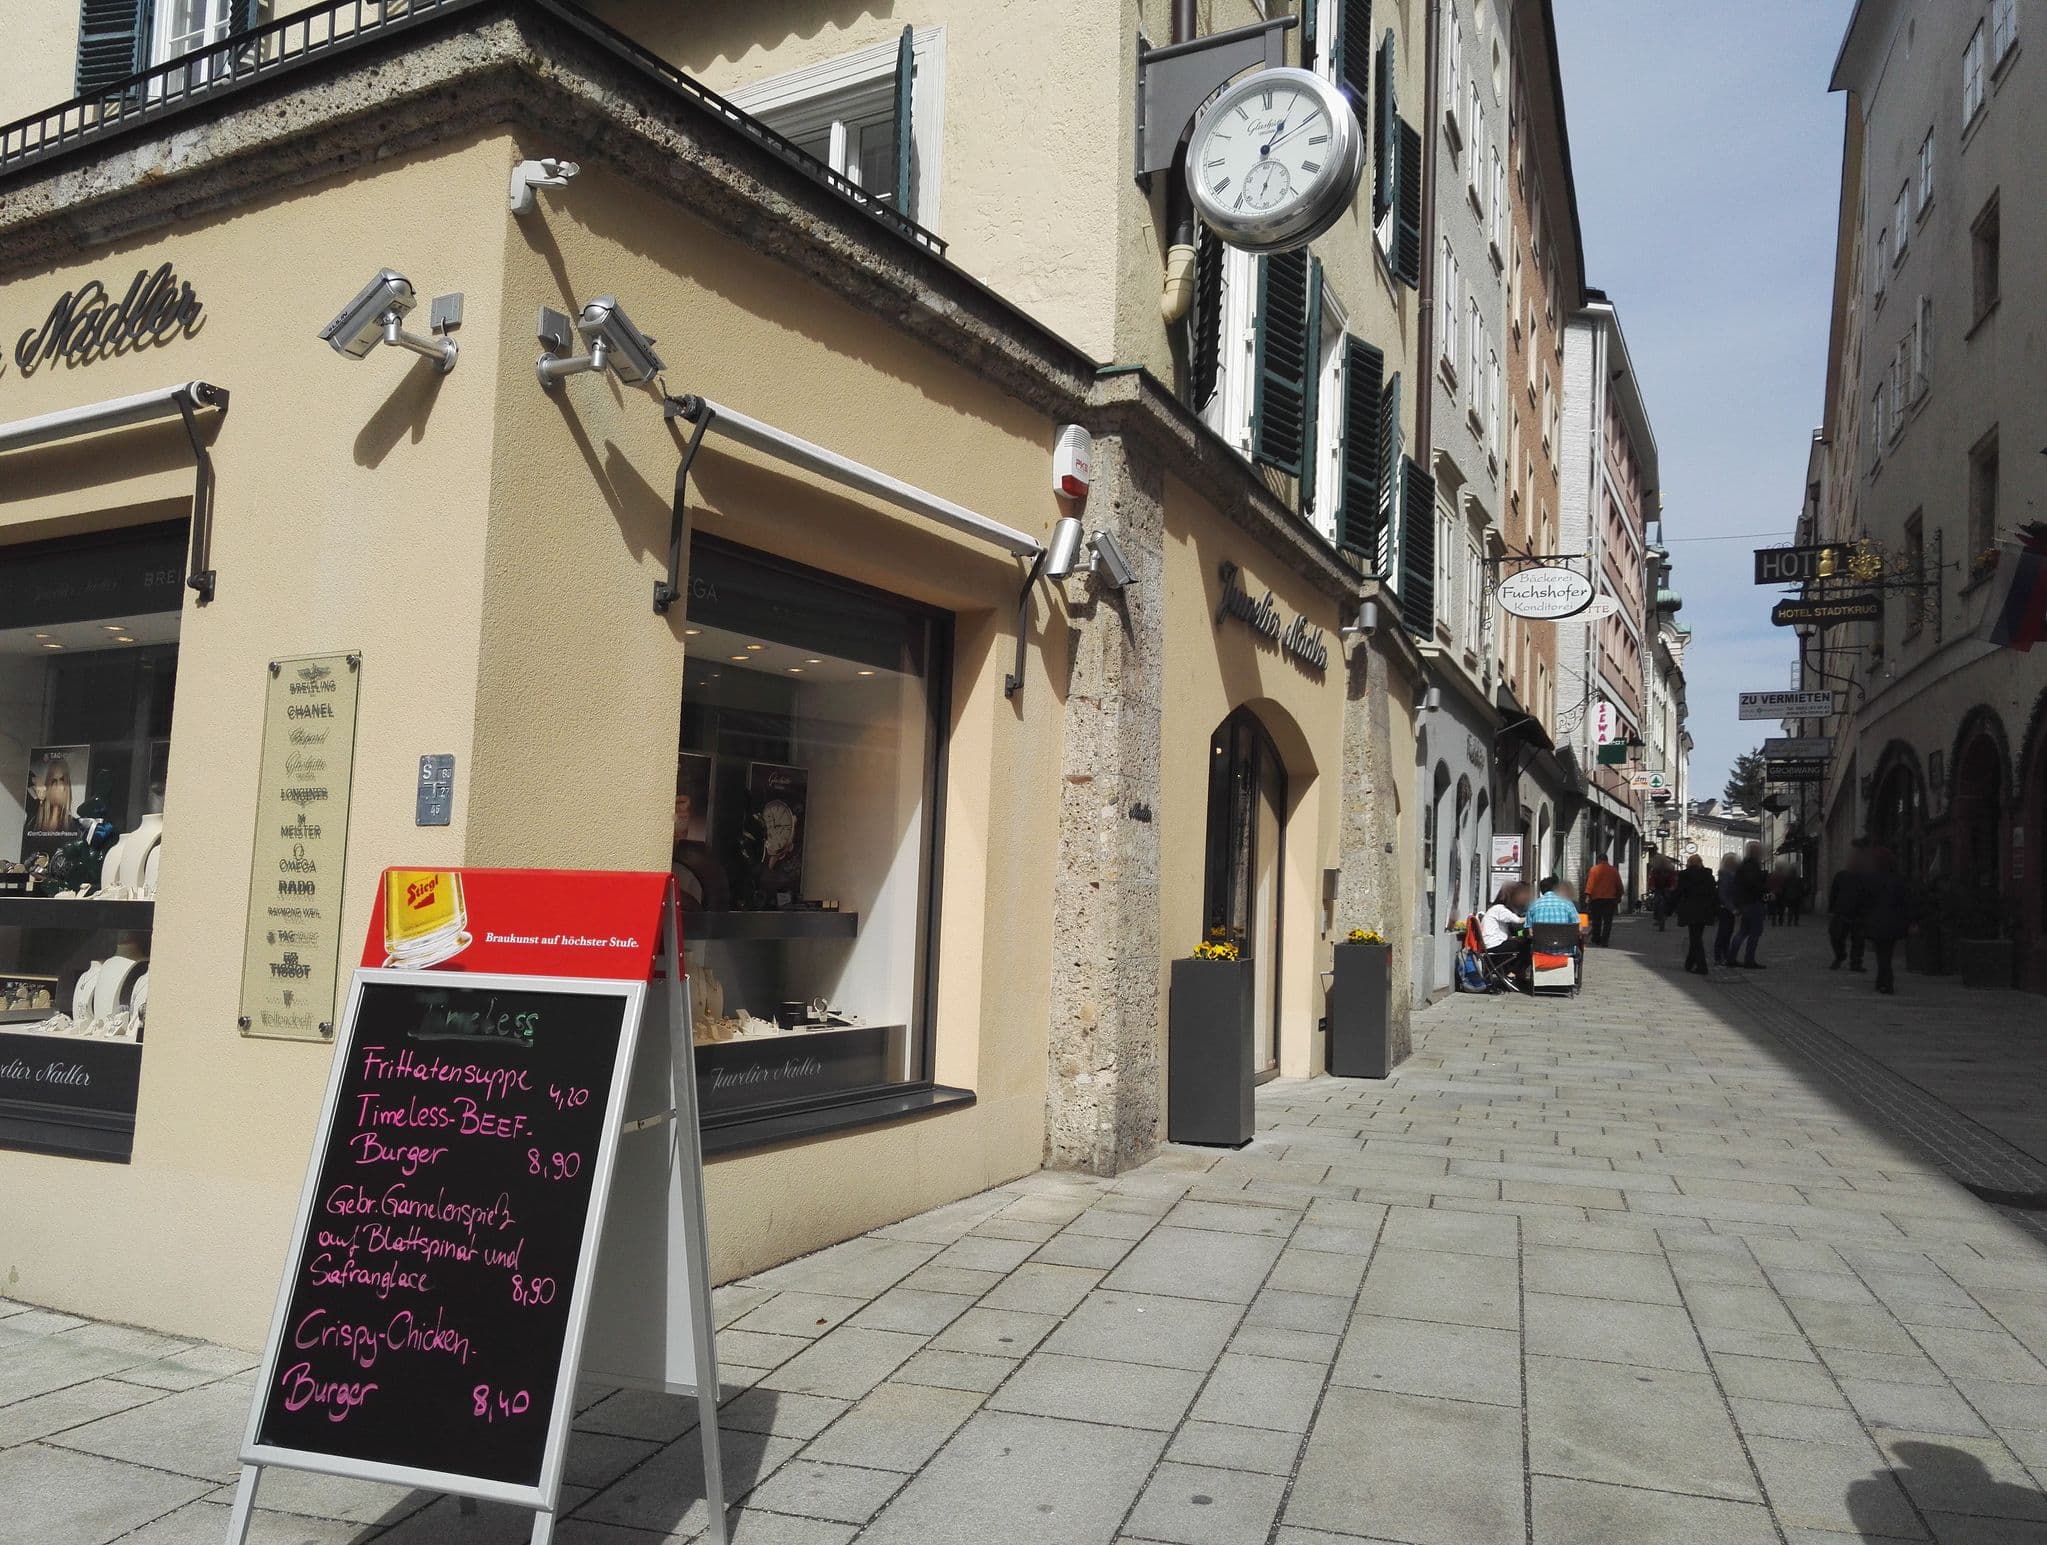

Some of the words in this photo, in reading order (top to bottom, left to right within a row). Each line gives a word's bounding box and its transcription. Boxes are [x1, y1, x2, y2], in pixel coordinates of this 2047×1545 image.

[15, 262, 203, 367] Nadler
[1519, 573, 1572, 583] Bäckerei
[1502, 584, 1587, 601] Fuchshofer
[1514, 601, 1573, 612] Konditorei
[1778, 608, 1812, 618] HOTEL
[1814, 604, 1878, 617] STADTKRUG
[1280, 614, 1328, 671] Nadler
[1741, 695, 1757, 705] ZU
[1761, 692, 1830, 704] VERMIETEN
[287, 703, 334, 720] CHANEL
[280, 825, 321, 839] MEISTER
[279, 859, 316, 873] OMEGA
[278, 880, 316, 895] RADO
[406, 874, 439, 906] Stiegl
[485, 931, 539, 944] Braukunst
[541, 935, 561, 945] auf
[561, 935, 607, 947] höchster
[608, 936, 640, 948] Stufe.
[0, 1058, 31, 1080] elier
[35, 1061, 91, 1085] Nadler
[711, 1063, 768, 1093] Juwelier
[774, 1056, 822, 1081] Nadler
[350, 1132, 449, 1176] Burger
[528, 1148, 581, 1180] 8,90
[326, 1184, 379, 1216] Gebr.
[318, 1225, 360, 1257] auf
[362, 1222, 478, 1263] Blattspinat
[484, 1238, 525, 1271] und
[511, 1274, 556, 1307] 8,90
[281, 1362, 378, 1422] Burger
[472, 1384, 530, 1424] 8,40
